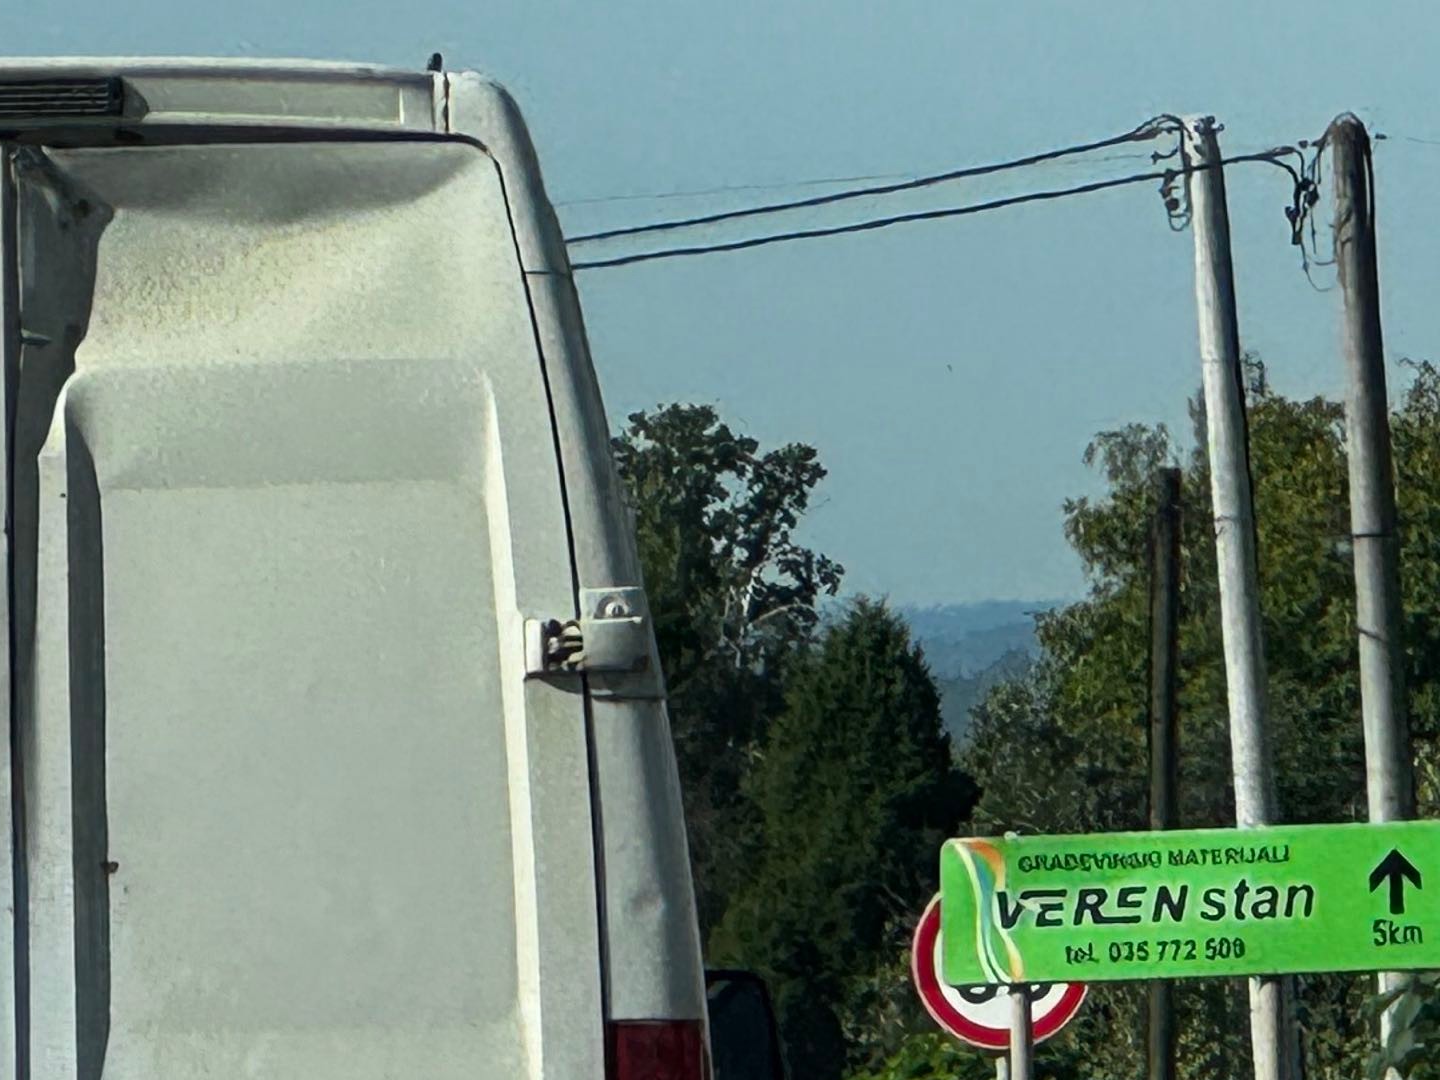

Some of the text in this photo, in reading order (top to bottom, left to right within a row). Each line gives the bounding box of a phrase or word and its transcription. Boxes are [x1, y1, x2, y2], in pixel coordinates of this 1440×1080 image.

[997, 878, 1314, 929] VEREN stan
[1373, 919, 1424, 947] 5km
[1155, 939, 1197, 962] 772
